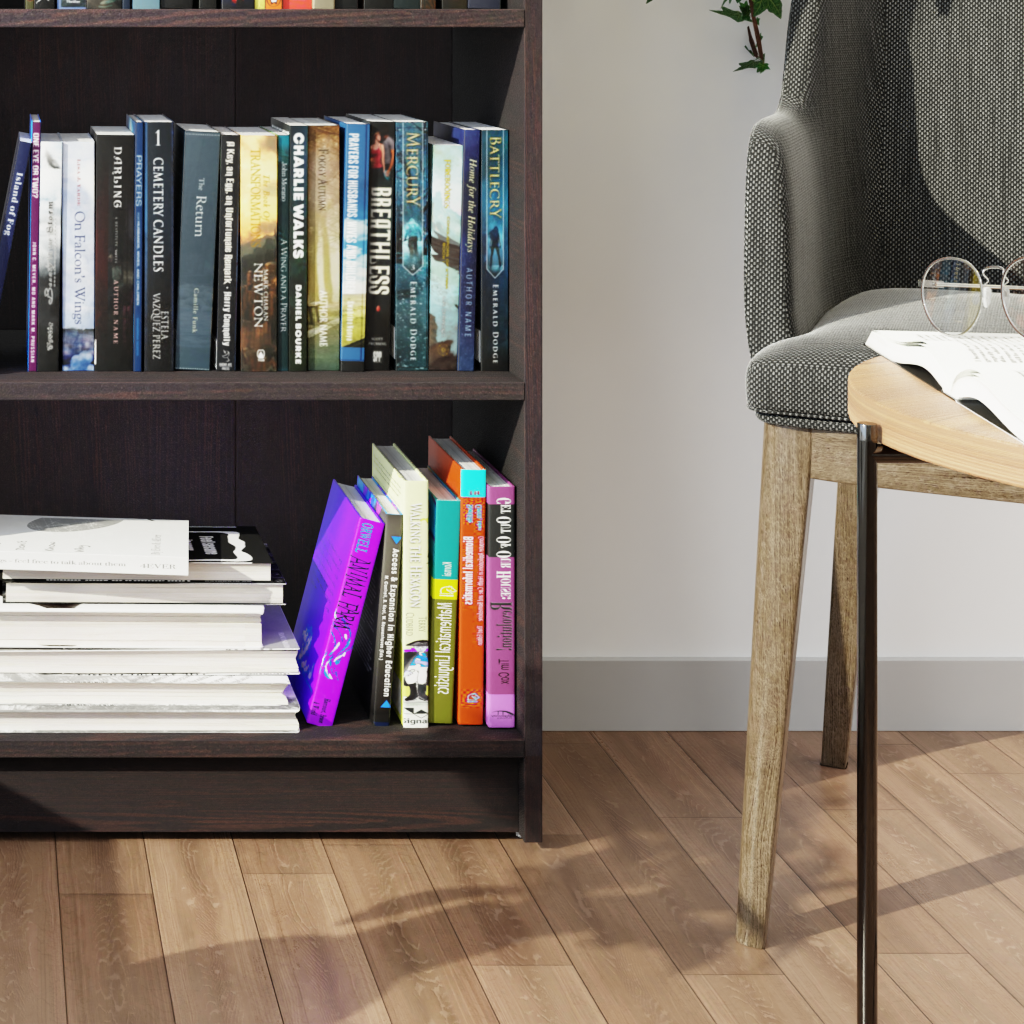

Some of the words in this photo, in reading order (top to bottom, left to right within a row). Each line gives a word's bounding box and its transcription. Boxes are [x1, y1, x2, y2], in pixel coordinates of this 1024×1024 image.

[31, 132, 40, 148] ONE
[31, 149, 40, 164] EYE
[347, 132, 360, 164] PRAYERS
[31, 165, 40, 176] OR
[111, 146, 123, 209] DARLING
[292, 132, 304, 202] CHARLIE
[317, 149, 329, 176] FOGGY
[347, 165, 359, 179] FOR
[405, 132, 421, 208] MERCURY
[488, 136, 502, 219] BATTLECRY
[31, 177, 40, 198] TWO?
[152, 156, 164, 217] CEMETERY
[197, 177, 206, 191] The
[250, 149, 261, 248] TRANSFORMATIONS
[317, 178, 329, 211] AUTUMN
[345, 180, 358, 219] HUSBANDS,
[74, 211, 86, 231] On
[194, 195, 207, 237] Return
[292, 204, 304, 259] WALKS
[345, 221, 358, 243] WIVES
[152, 220, 164, 273] CANDLES
[345, 245, 357, 260] AND
[368, 186, 392, 296] BREATHLESS
[74, 235, 86, 283] Falcon's
[345, 261, 358, 294] CHILDREN
[464, 267, 474, 305] AUTHOR
[72, 286, 86, 325] Wings
[150, 292, 162, 332] VAZQUEZ
[253, 263, 264, 328] NEWTON
[294, 284, 303, 321] DANIEL
[318, 290, 328, 323] AUTHOR
[161, 310, 170, 340] ESTELA
[318, 324, 328, 347] NAME
[463, 311, 473, 338] NAME
[151, 334, 162, 360] PEREZ
[294, 323, 303, 365] BOURKE
[354, 522, 374, 553] ORWELL
[409, 503, 423, 544] WALKING
[139, 562, 176, 570] 4EVER
[410, 546, 422, 563] THE
[342, 555, 371, 597] ANIMAL
[410, 565, 422, 609] HEXAGON
[333, 600, 360, 629] FARM
